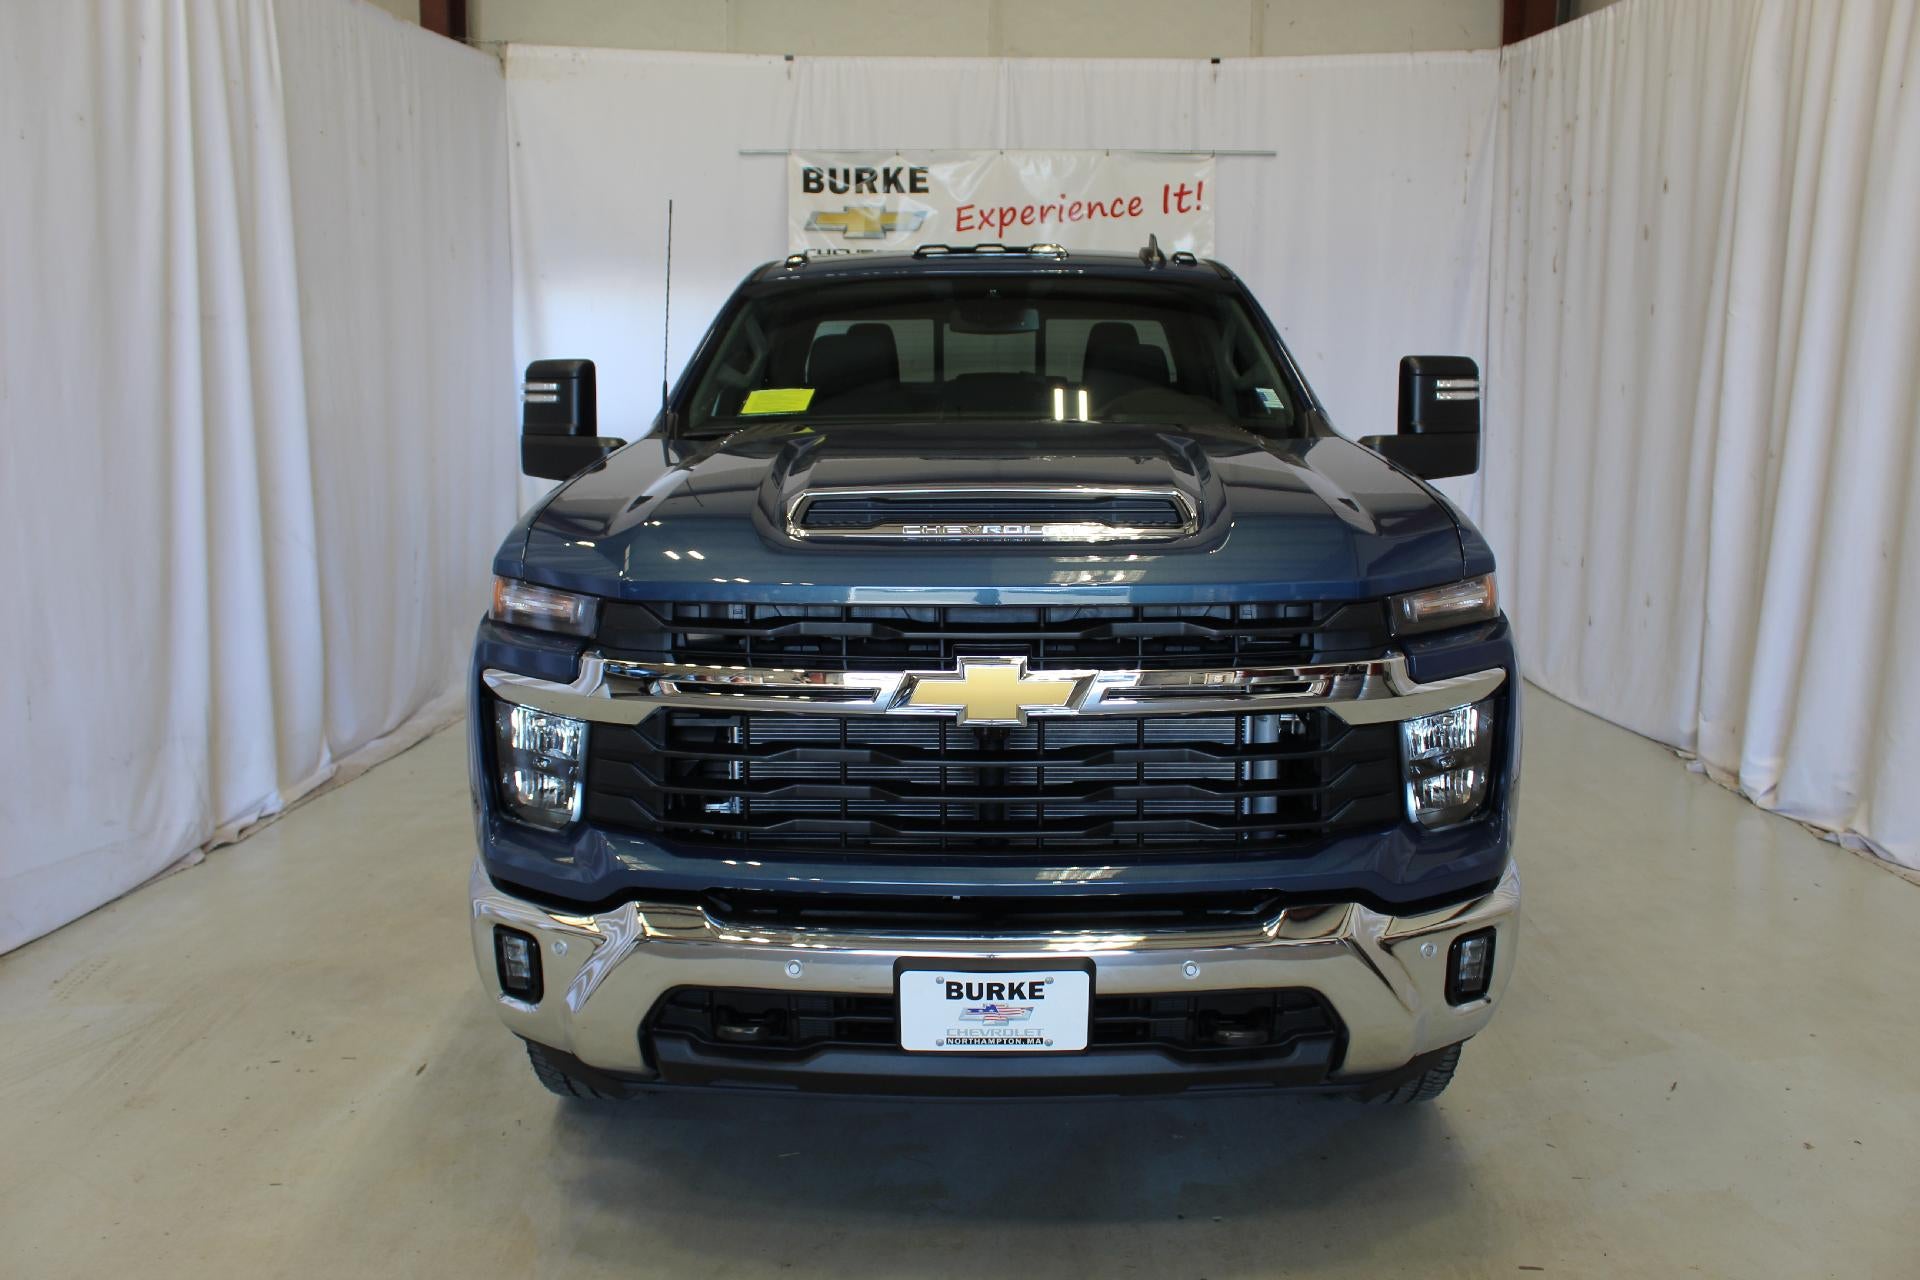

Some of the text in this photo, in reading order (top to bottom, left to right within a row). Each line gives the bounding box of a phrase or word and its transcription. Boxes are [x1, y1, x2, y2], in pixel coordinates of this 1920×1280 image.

[803, 166, 929, 195] BURKE
[955, 180, 1204, 239] Experience It!
[902, 524, 1082, 535] CHEVROL
[945, 981, 1045, 1000] BURKE
[946, 1028, 1045, 1037] CHEVROLET
[1027, 1037, 1041, 1045] MA
